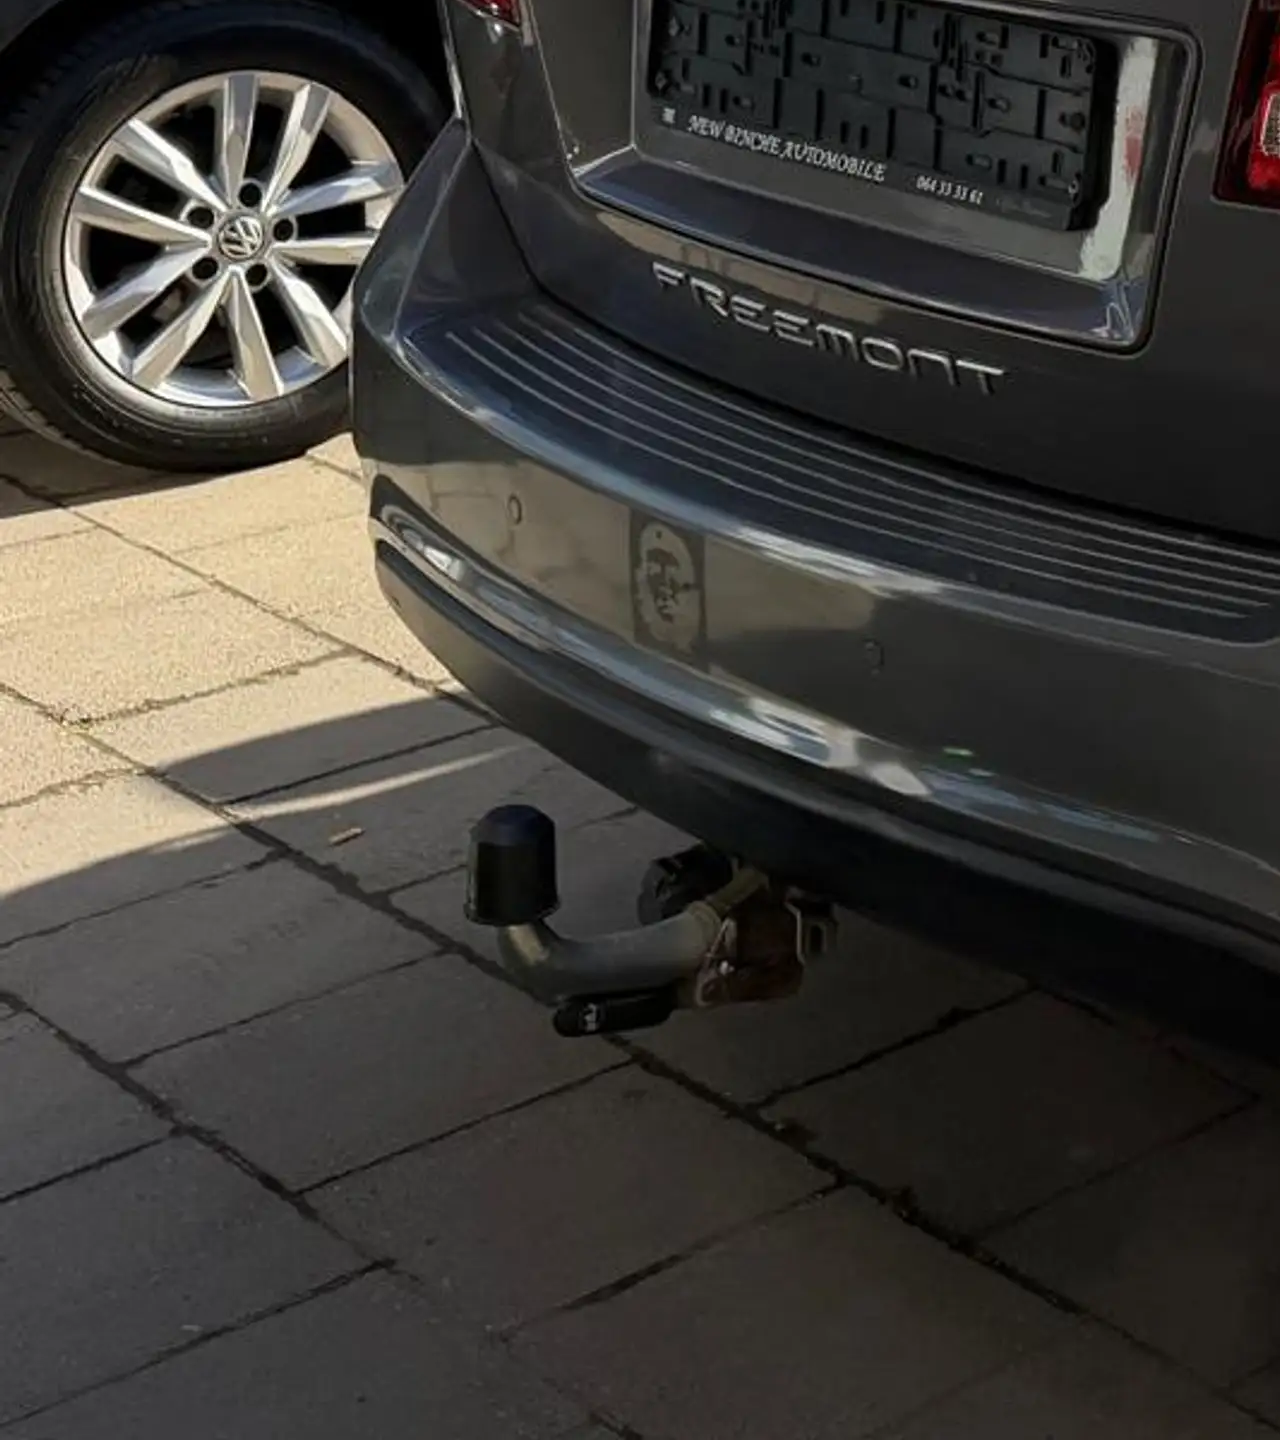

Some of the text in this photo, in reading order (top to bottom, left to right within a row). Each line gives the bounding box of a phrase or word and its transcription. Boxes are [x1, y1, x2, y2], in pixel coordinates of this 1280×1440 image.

[688, 114, 725, 140] NEW
[780, 139, 887, 183] AUTOMOBILE
[652, 260, 1006, 396] FREEMONT
